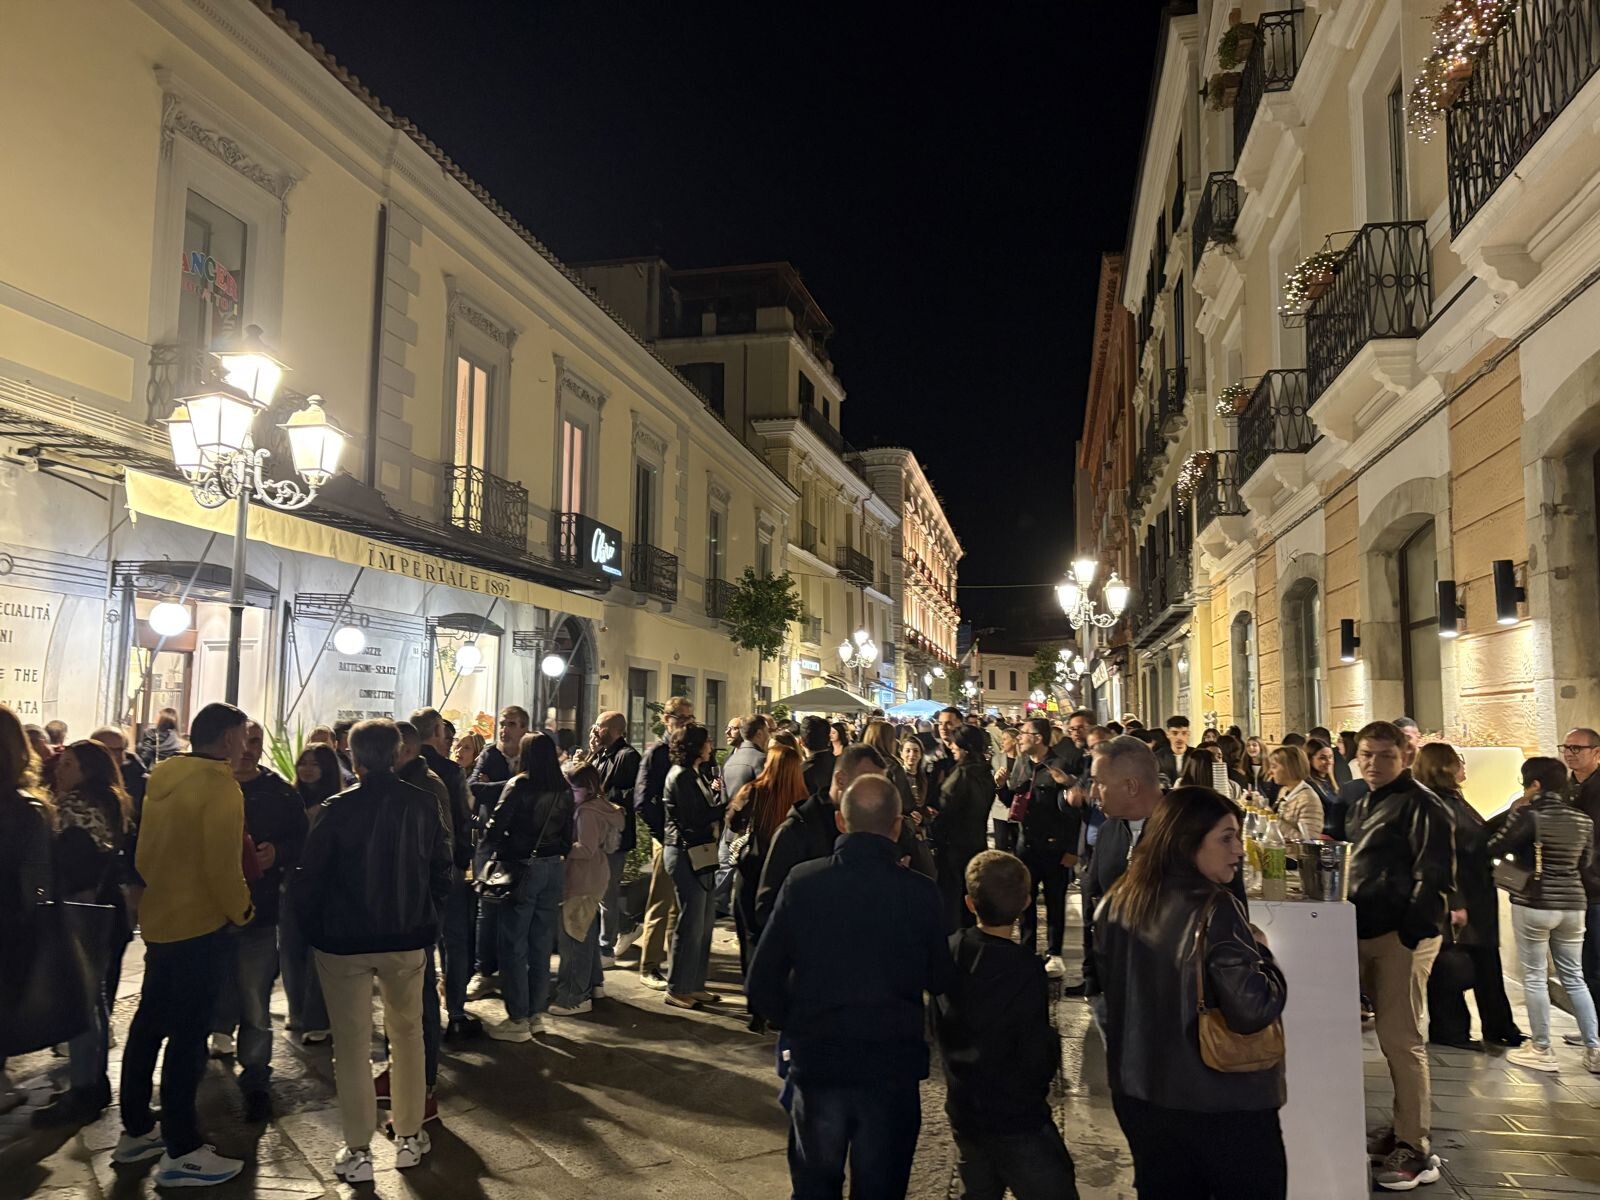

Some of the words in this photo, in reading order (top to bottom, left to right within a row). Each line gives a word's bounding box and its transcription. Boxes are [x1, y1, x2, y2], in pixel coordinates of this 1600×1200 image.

[368, 549, 479, 590] IMPERIALE
[485, 579, 510, 598] 1892
[14, 668, 39, 682] THE
